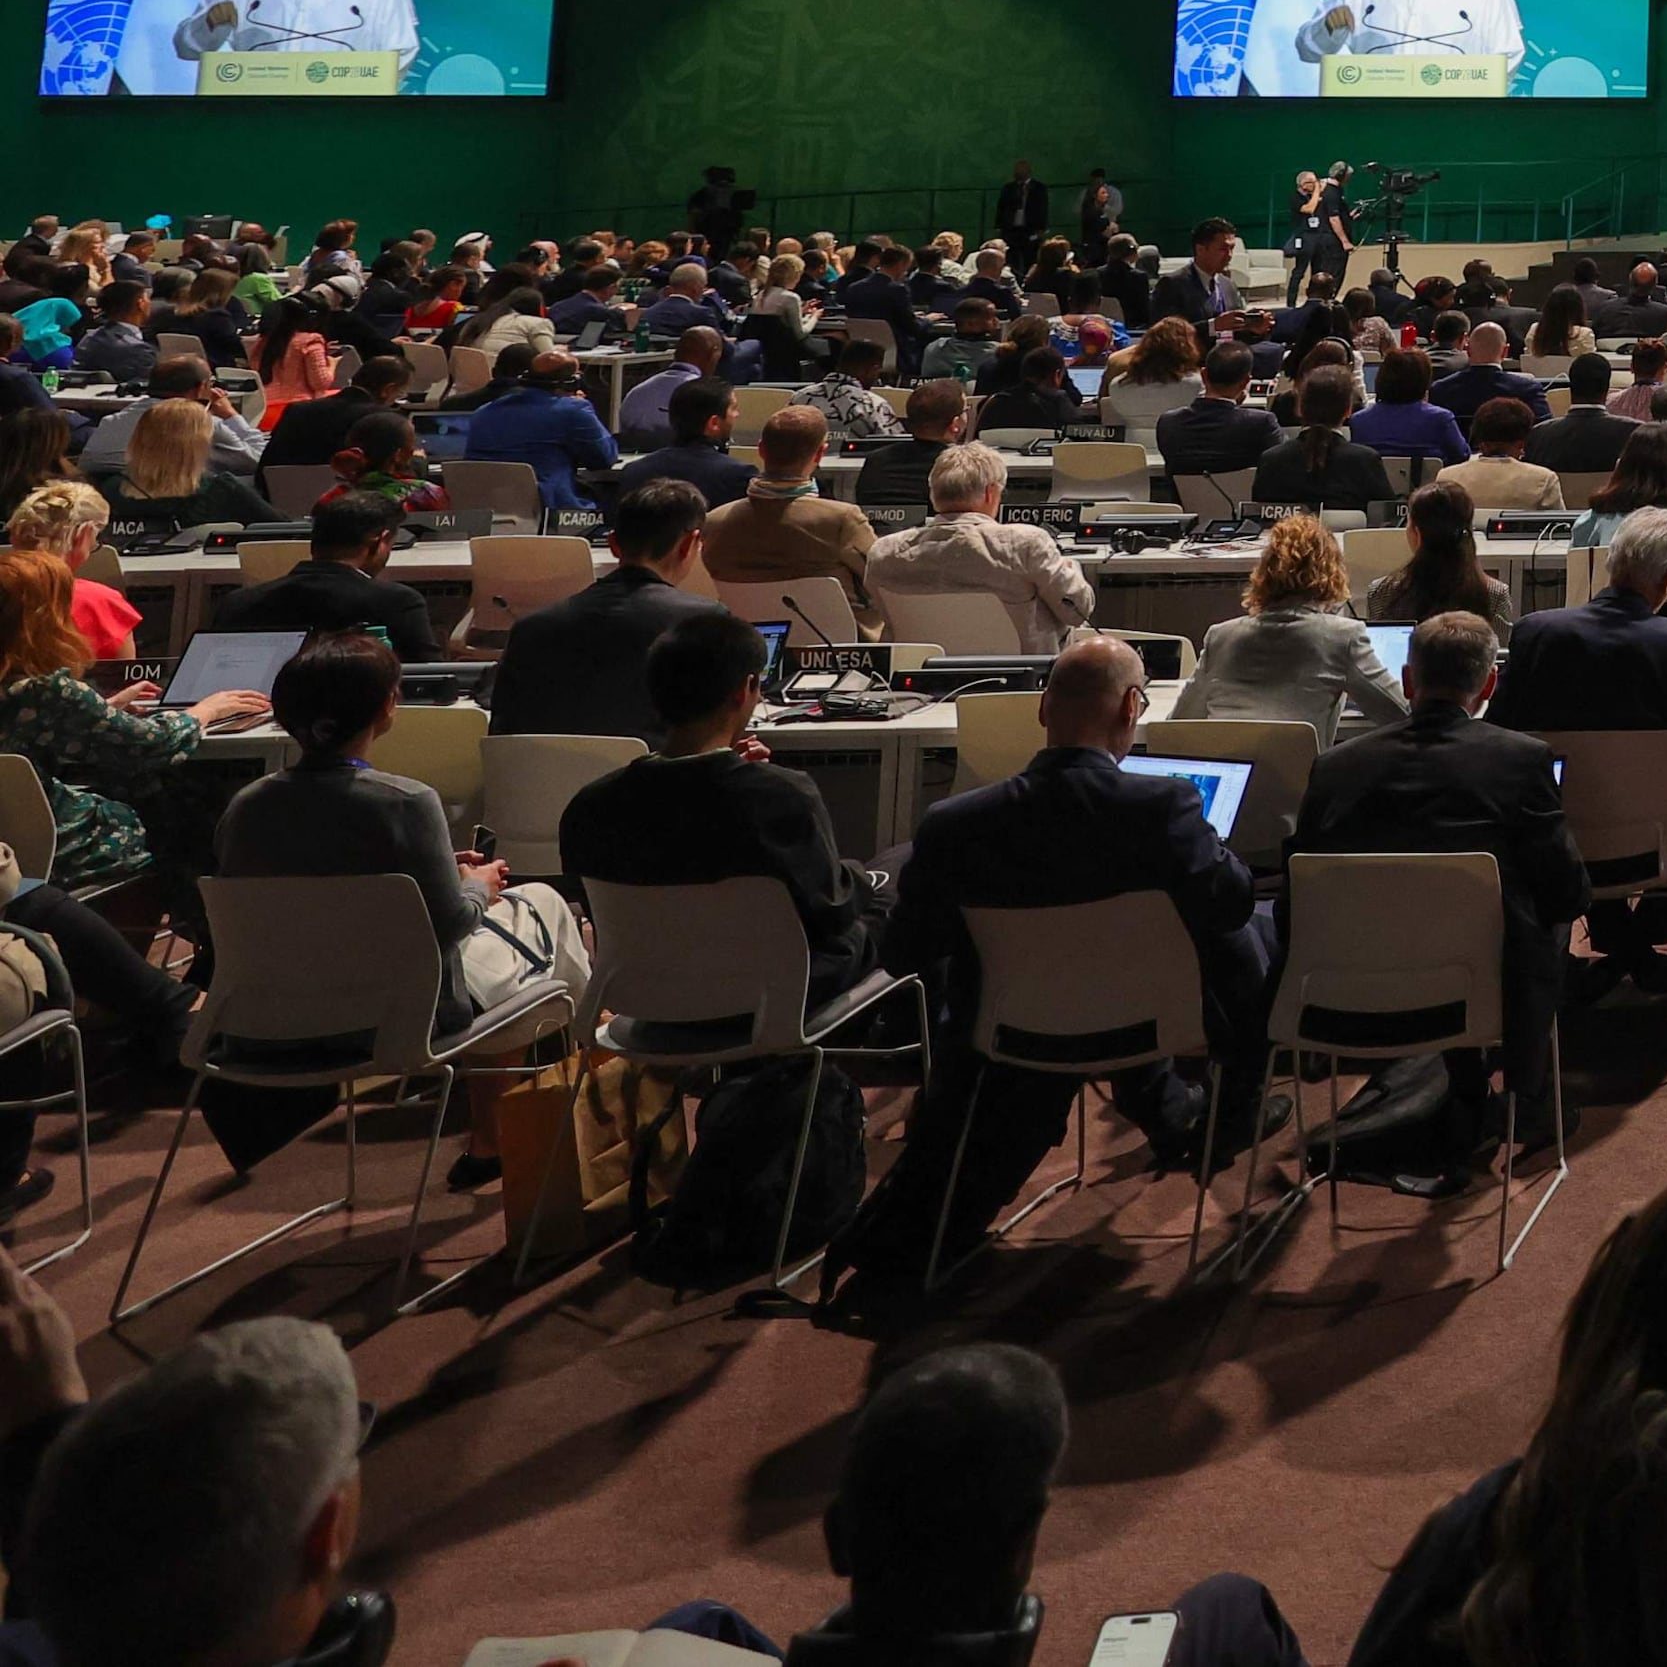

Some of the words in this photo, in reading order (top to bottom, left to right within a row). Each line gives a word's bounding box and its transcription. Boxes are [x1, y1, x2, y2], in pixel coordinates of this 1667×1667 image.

[332, 66, 379, 78] COPUAE
[1445, 69, 1488, 80] COPUAE
[1073, 428, 1115, 438] TUVALU
[435, 515, 456, 527] IAI
[558, 511, 605, 526] ICARDA
[867, 509, 906, 521] CIMOD
[1043, 508, 1074, 522] ERIC
[112, 520, 145, 536] IACA
[124, 664, 162, 681] IOM
